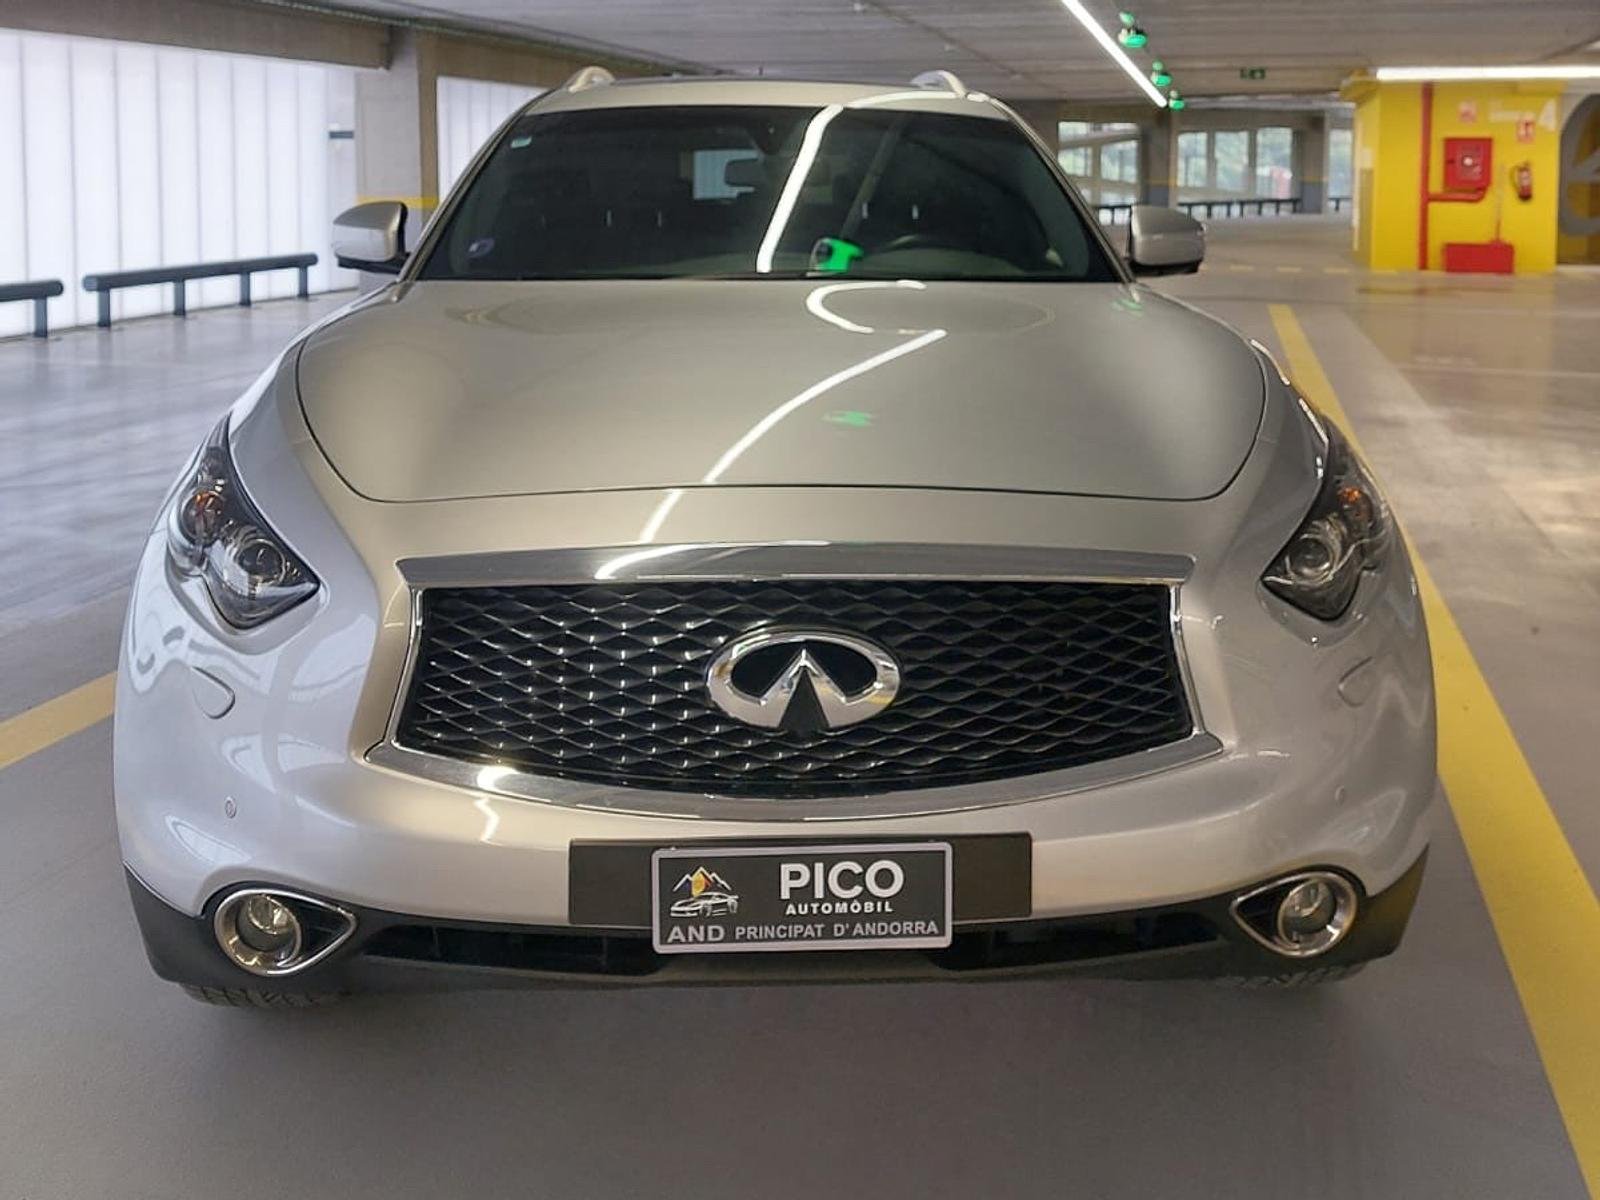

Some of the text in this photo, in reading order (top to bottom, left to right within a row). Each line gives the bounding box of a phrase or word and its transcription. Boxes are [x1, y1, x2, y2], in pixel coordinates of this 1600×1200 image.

[780, 860, 904, 900] PICO
[667, 925, 725, 943] AND
[735, 923, 826, 940] PRINCIPAT
